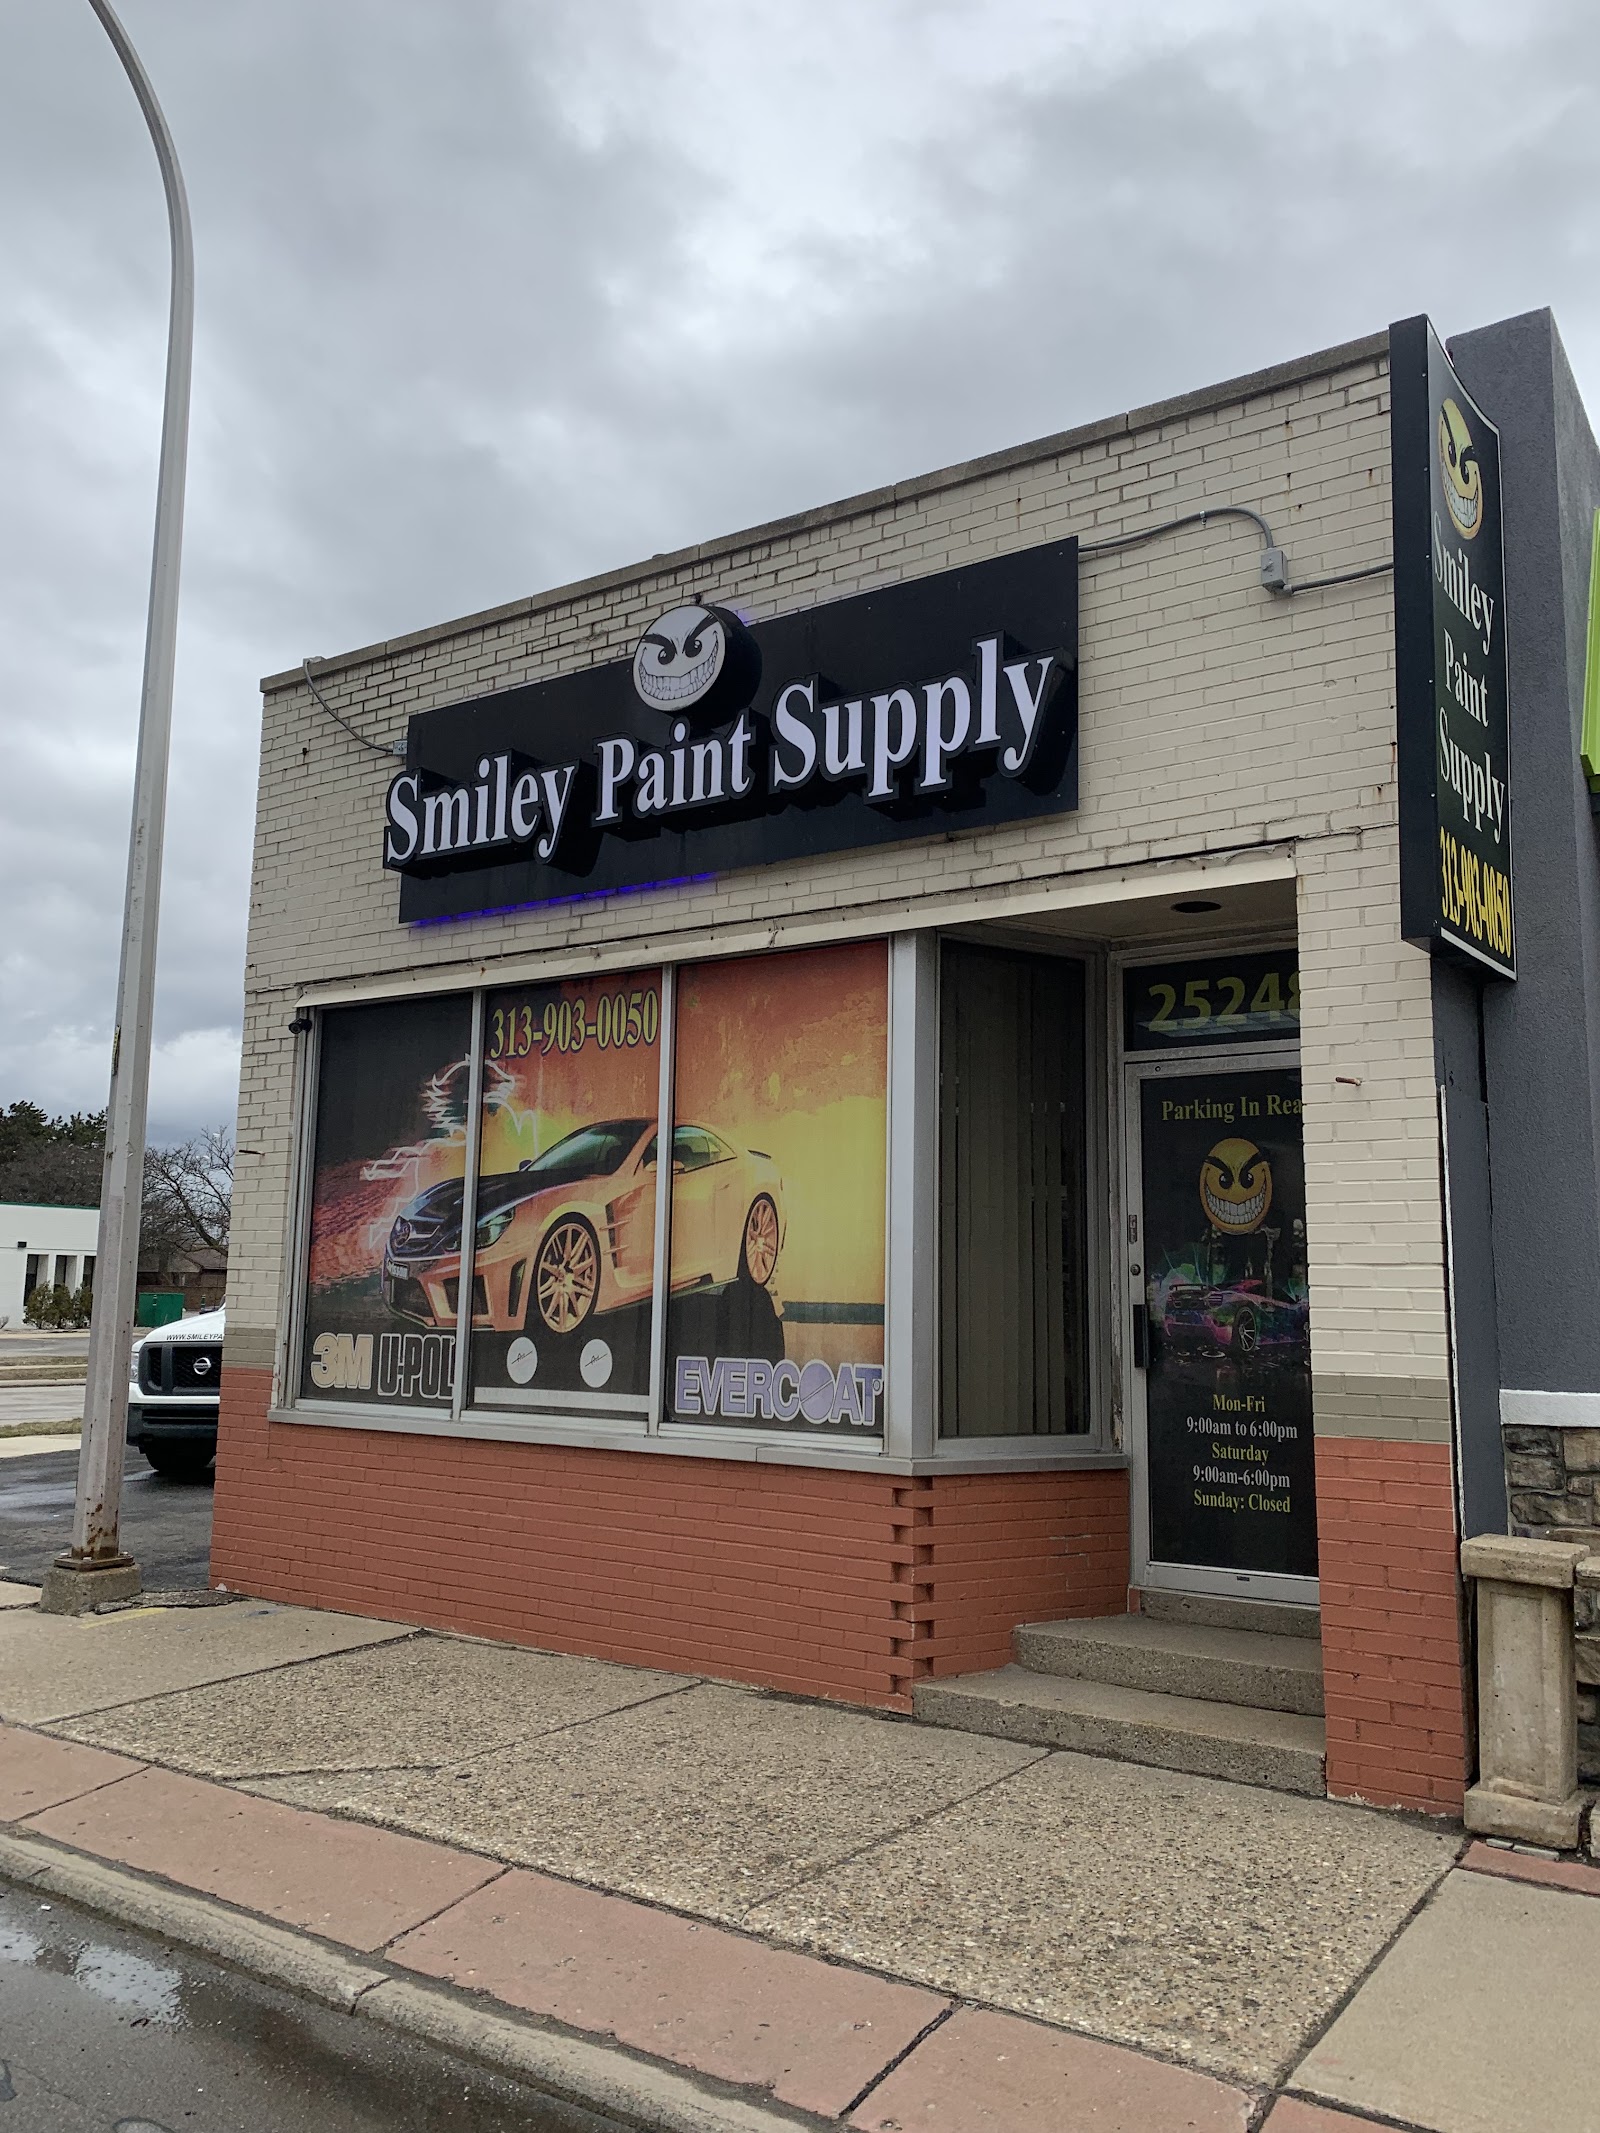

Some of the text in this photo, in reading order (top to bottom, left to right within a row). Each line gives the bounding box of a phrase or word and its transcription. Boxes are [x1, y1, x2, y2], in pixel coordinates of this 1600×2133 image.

[1434, 510, 1495, 656] Smiley
[1443, 627, 1488, 728] Paint
[386, 636, 1054, 864] Smiley Paint Supply
[1439, 706, 1506, 845] Supply
[1439, 825, 1512, 959] 313-903-0050
[489, 989, 659, 1060] 313-903-0050
[1161, 1098, 1235, 1124] Parking
[1240, 1096, 1261, 1117] In
[311, 1332, 374, 1390] 3M
[674, 1355, 882, 1426] EVERCOAT
[1186, 1416, 1298, 1443] 9:00am to 6:00pm
[1212, 1394, 1266, 1413] Mon-Fri
[1192, 1464, 1291, 1492] 9:00am-6:00pm
[1211, 1442, 1270, 1467] Saturday
[1193, 1489, 1291, 1514] Sunday: Closed
